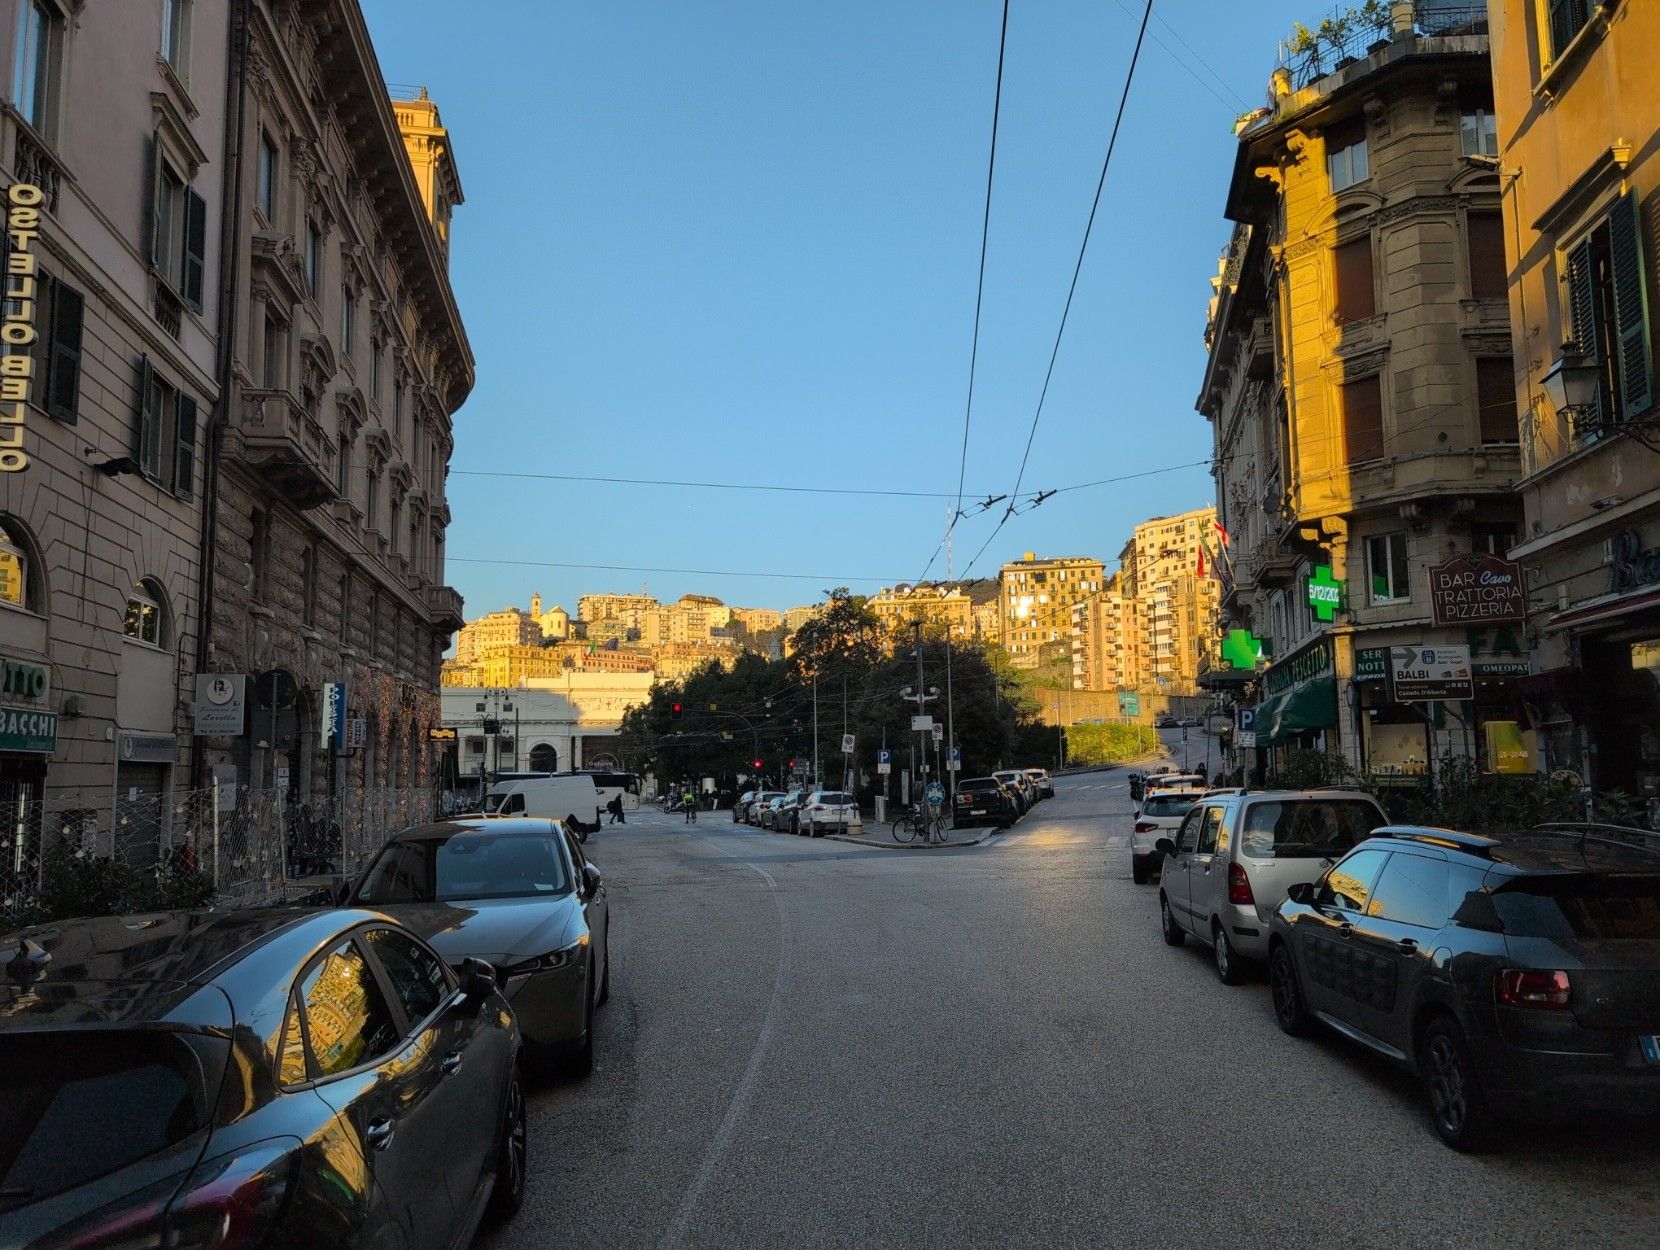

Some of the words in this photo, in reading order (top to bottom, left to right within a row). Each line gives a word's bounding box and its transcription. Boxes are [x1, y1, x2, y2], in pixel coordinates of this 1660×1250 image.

[1440, 572, 1475, 589] BAR
[1480, 570, 1512, 585] Cavo
[1435, 585, 1522, 604] TRATTORIA
[1446, 602, 1515, 619] PIZZERIA
[1362, 649, 1384, 660] SER
[1397, 669, 1430, 680] BALBI
[1242, 711, 1253, 729] P
[880, 751, 889, 763] P
